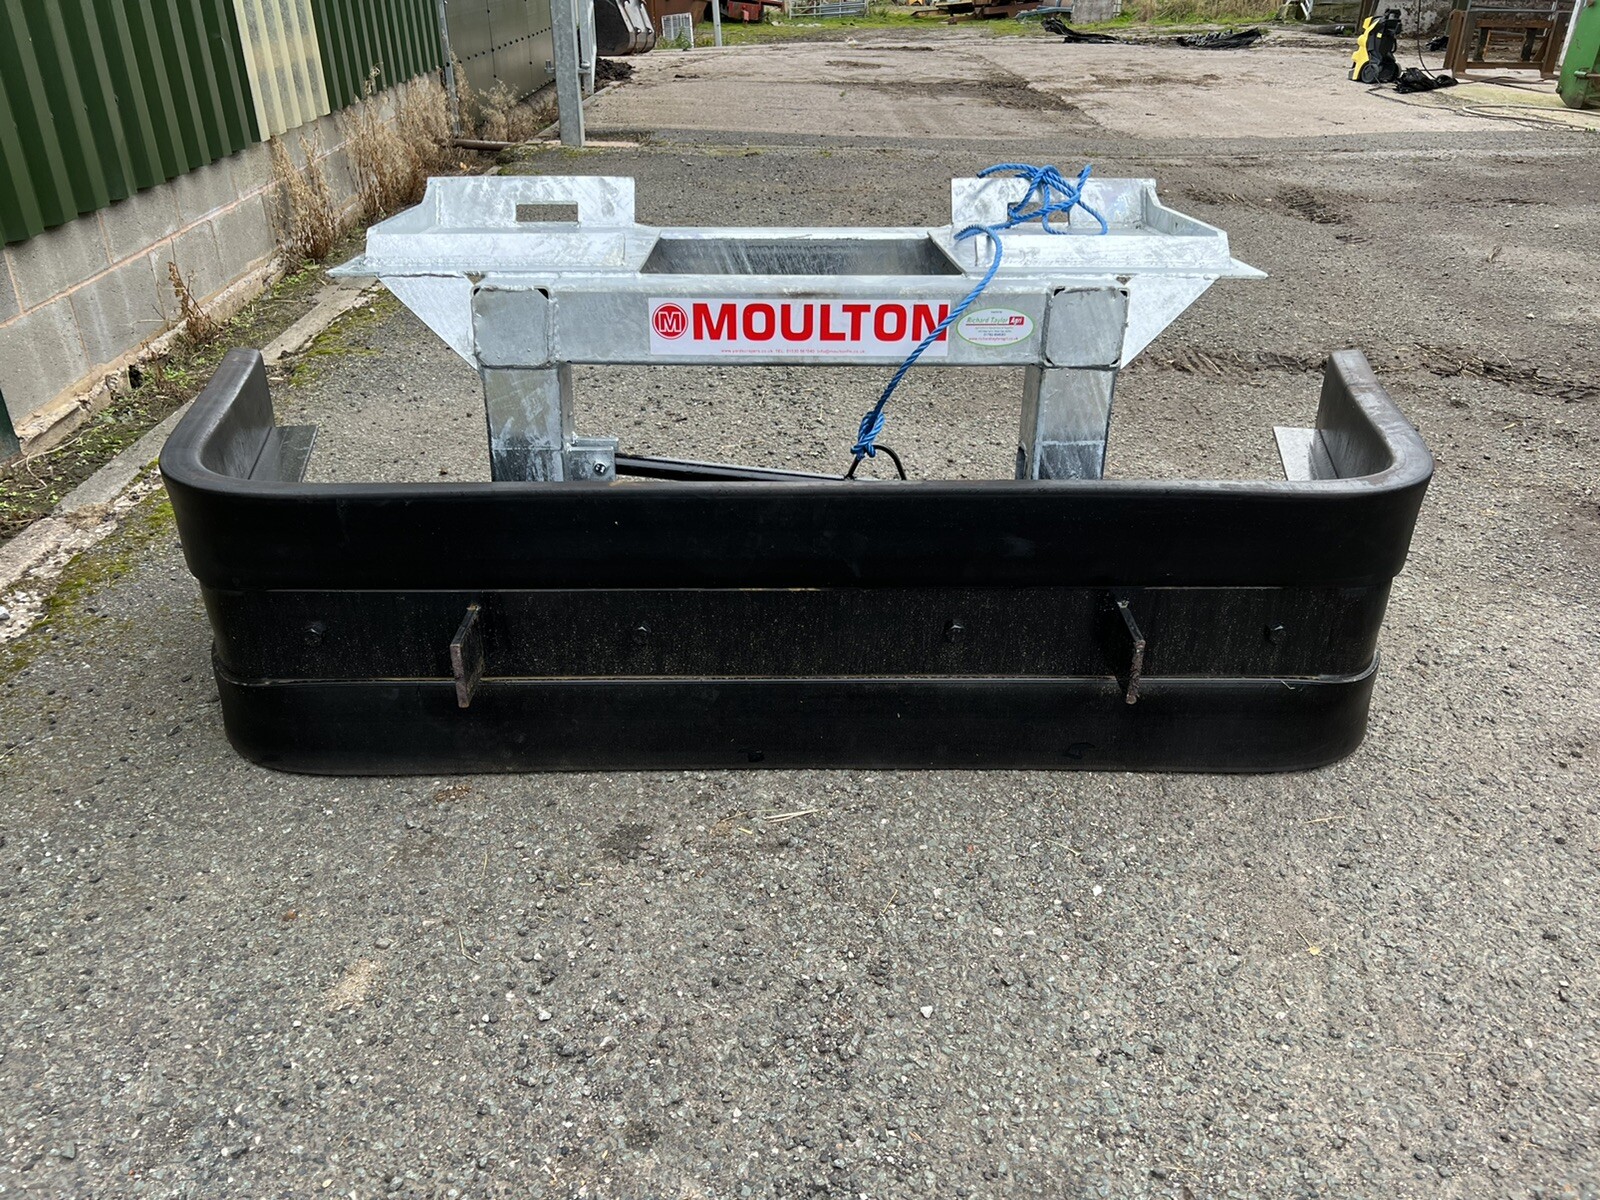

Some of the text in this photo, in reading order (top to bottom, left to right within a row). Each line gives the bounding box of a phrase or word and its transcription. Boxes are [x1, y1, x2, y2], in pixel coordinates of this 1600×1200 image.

[658, 303, 949, 342] M MOULTON
[991, 316, 1009, 324] Taylor
[1010, 317, 1023, 325] Agri
